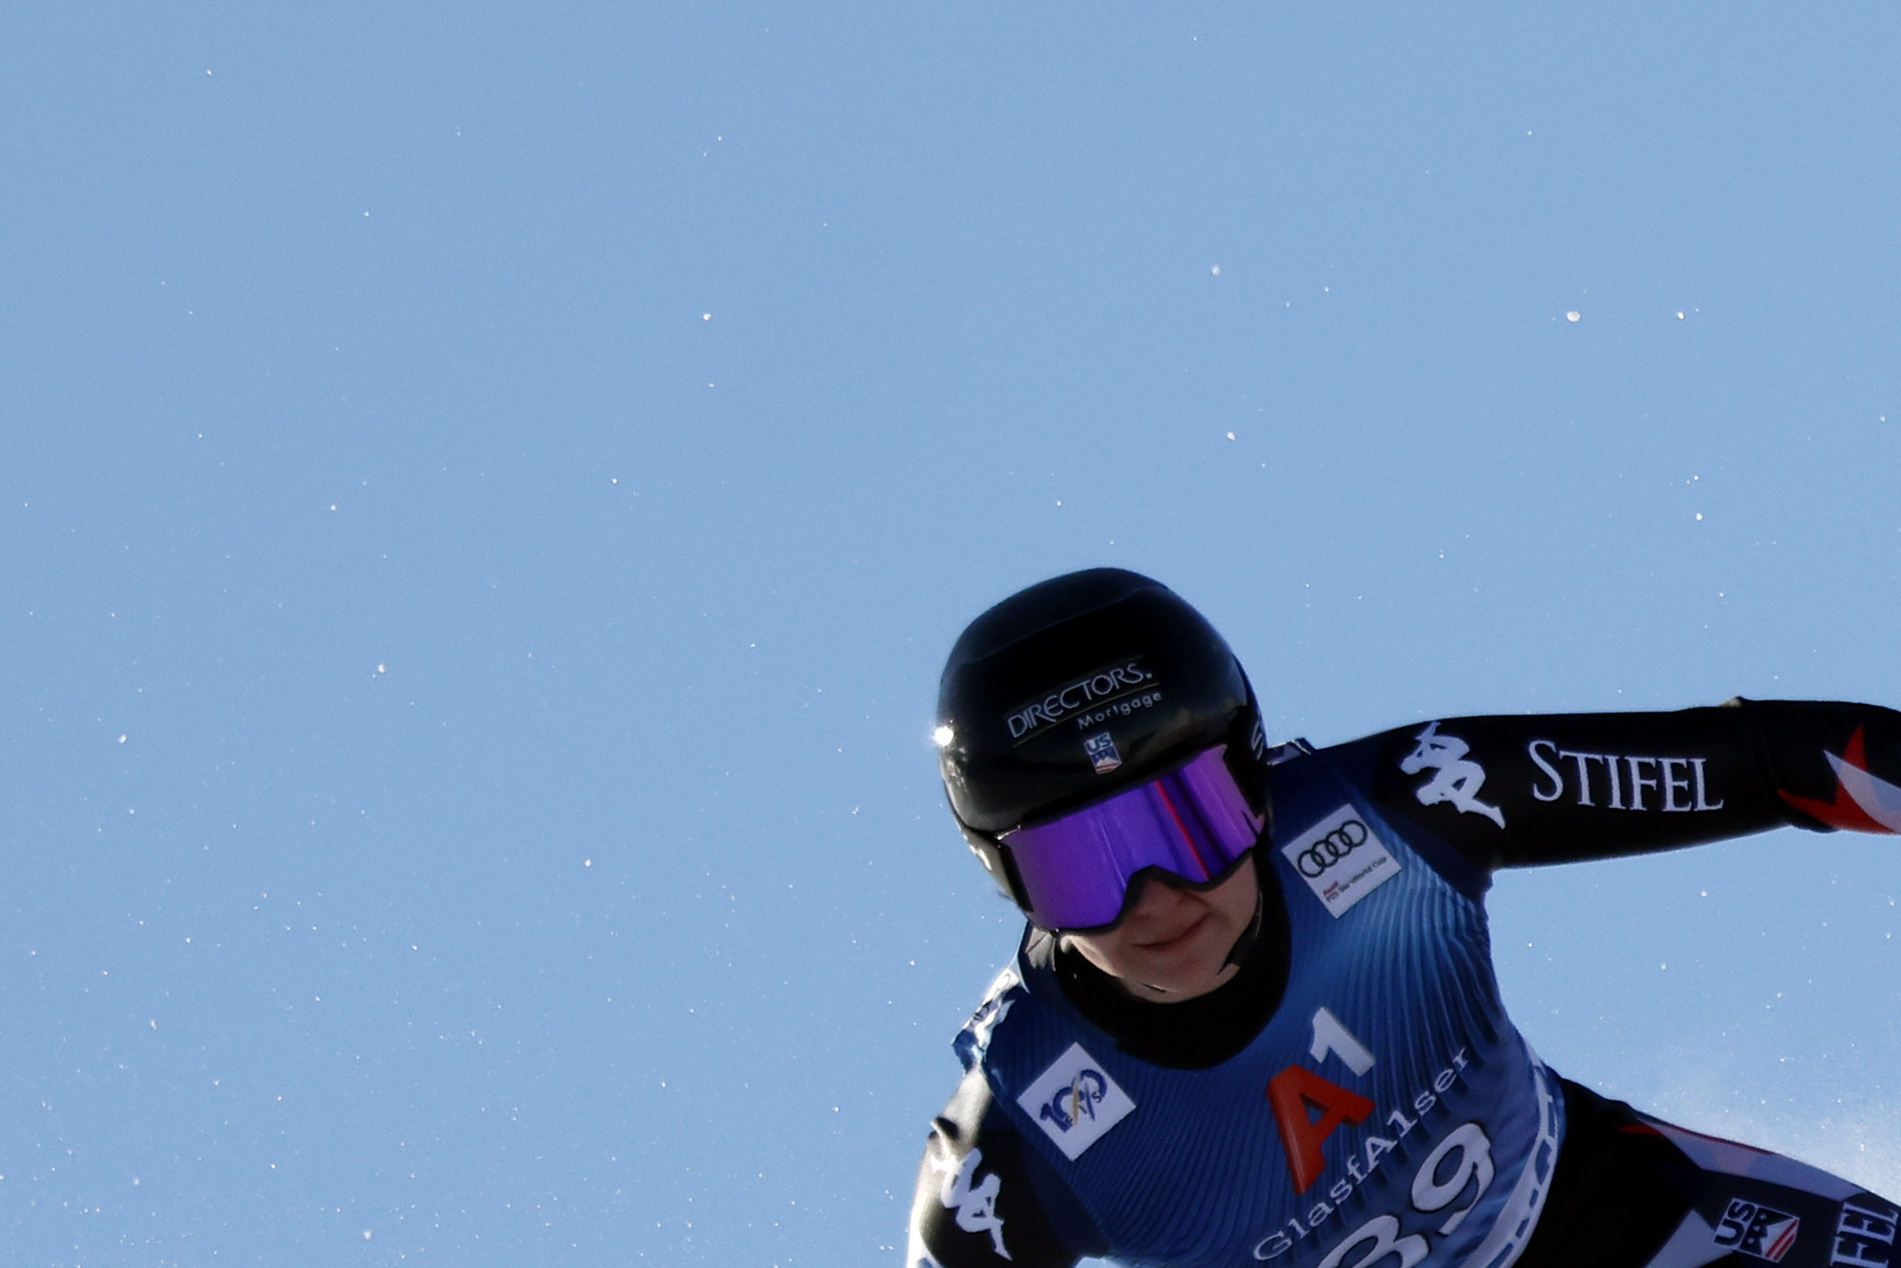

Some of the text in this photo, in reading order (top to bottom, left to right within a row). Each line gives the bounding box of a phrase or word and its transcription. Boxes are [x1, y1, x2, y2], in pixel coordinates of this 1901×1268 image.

[1077, 692, 1162, 730] Mortgage
[1086, 733, 1112, 754] US
[1528, 739, 1725, 813] STIFEL
[1266, 1006, 1377, 1197] A1
[1713, 1201, 1758, 1247] US
